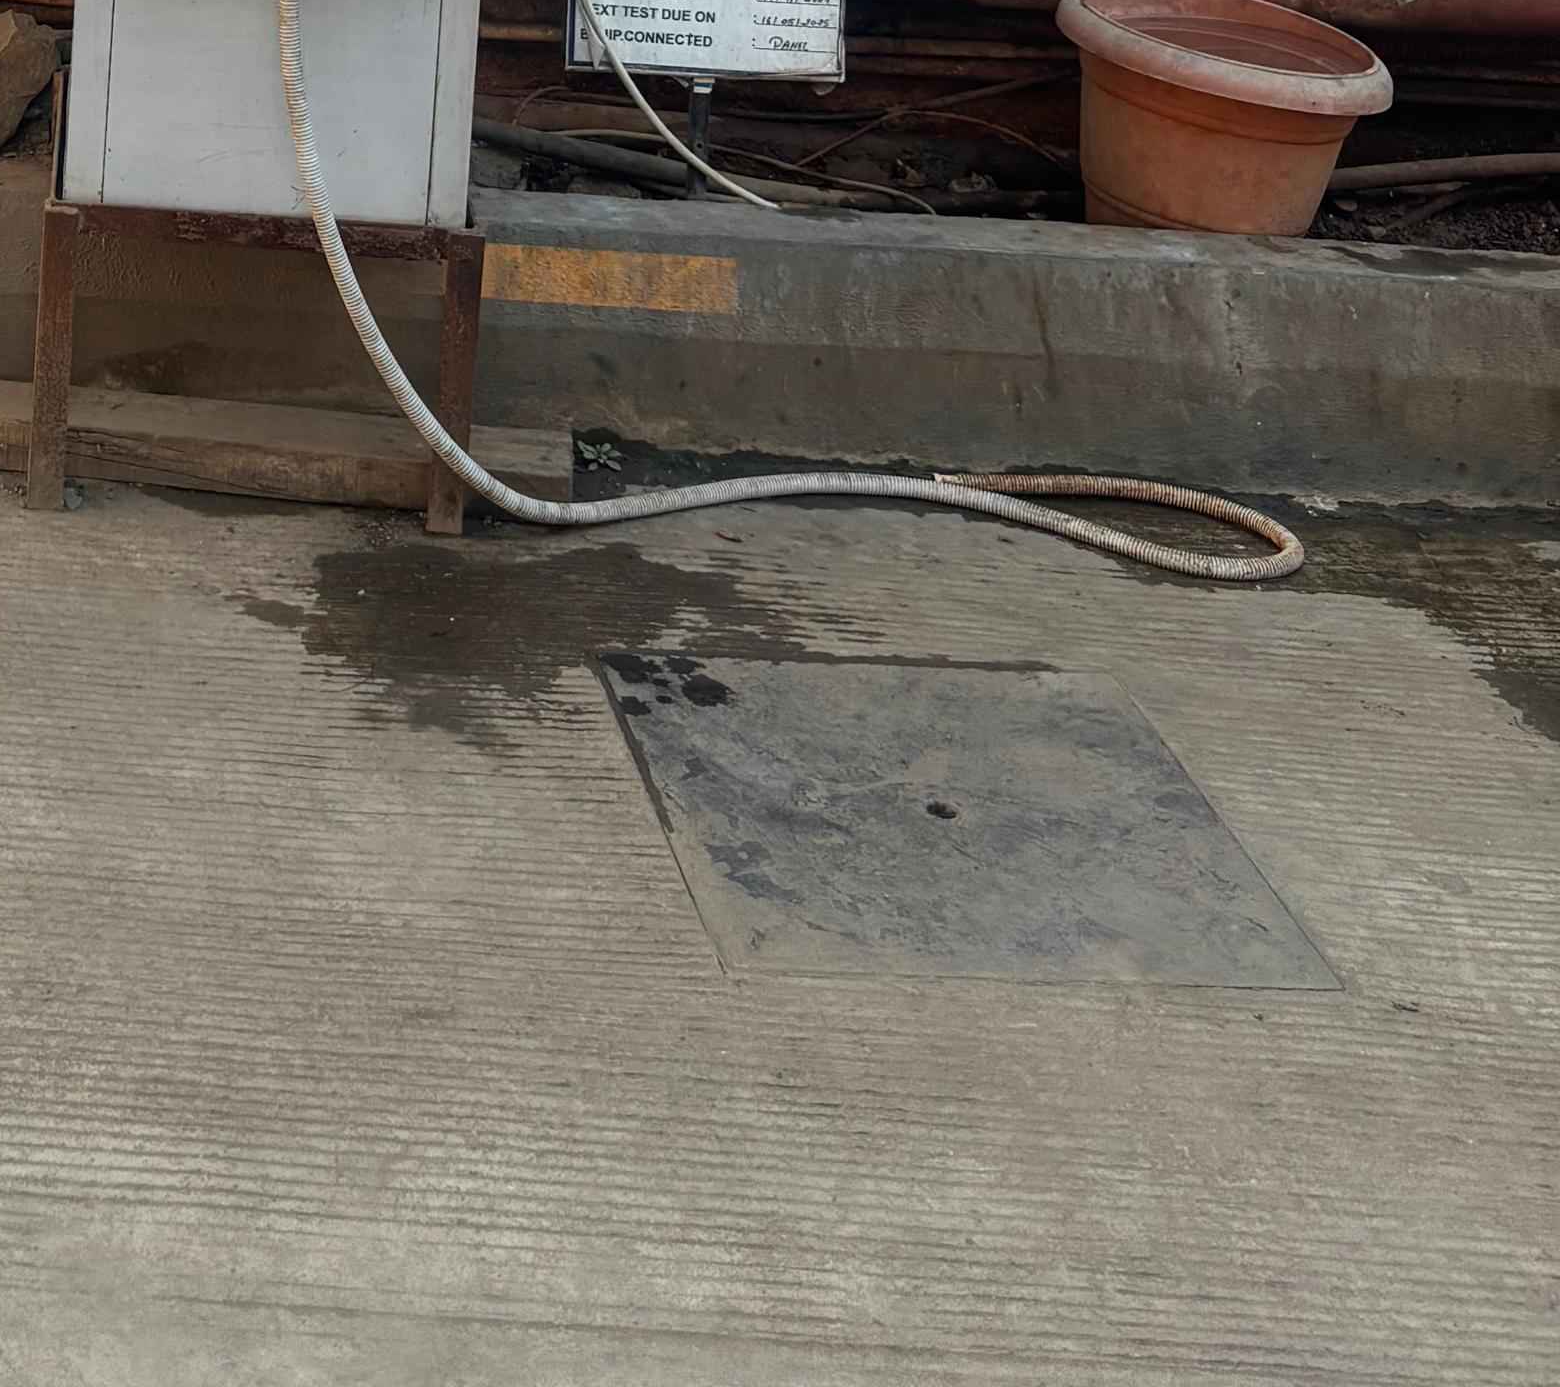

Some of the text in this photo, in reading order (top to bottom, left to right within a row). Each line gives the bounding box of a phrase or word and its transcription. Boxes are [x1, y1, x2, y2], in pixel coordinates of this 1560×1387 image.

[591, 3, 716, 24] EXT TEST DUE ON
